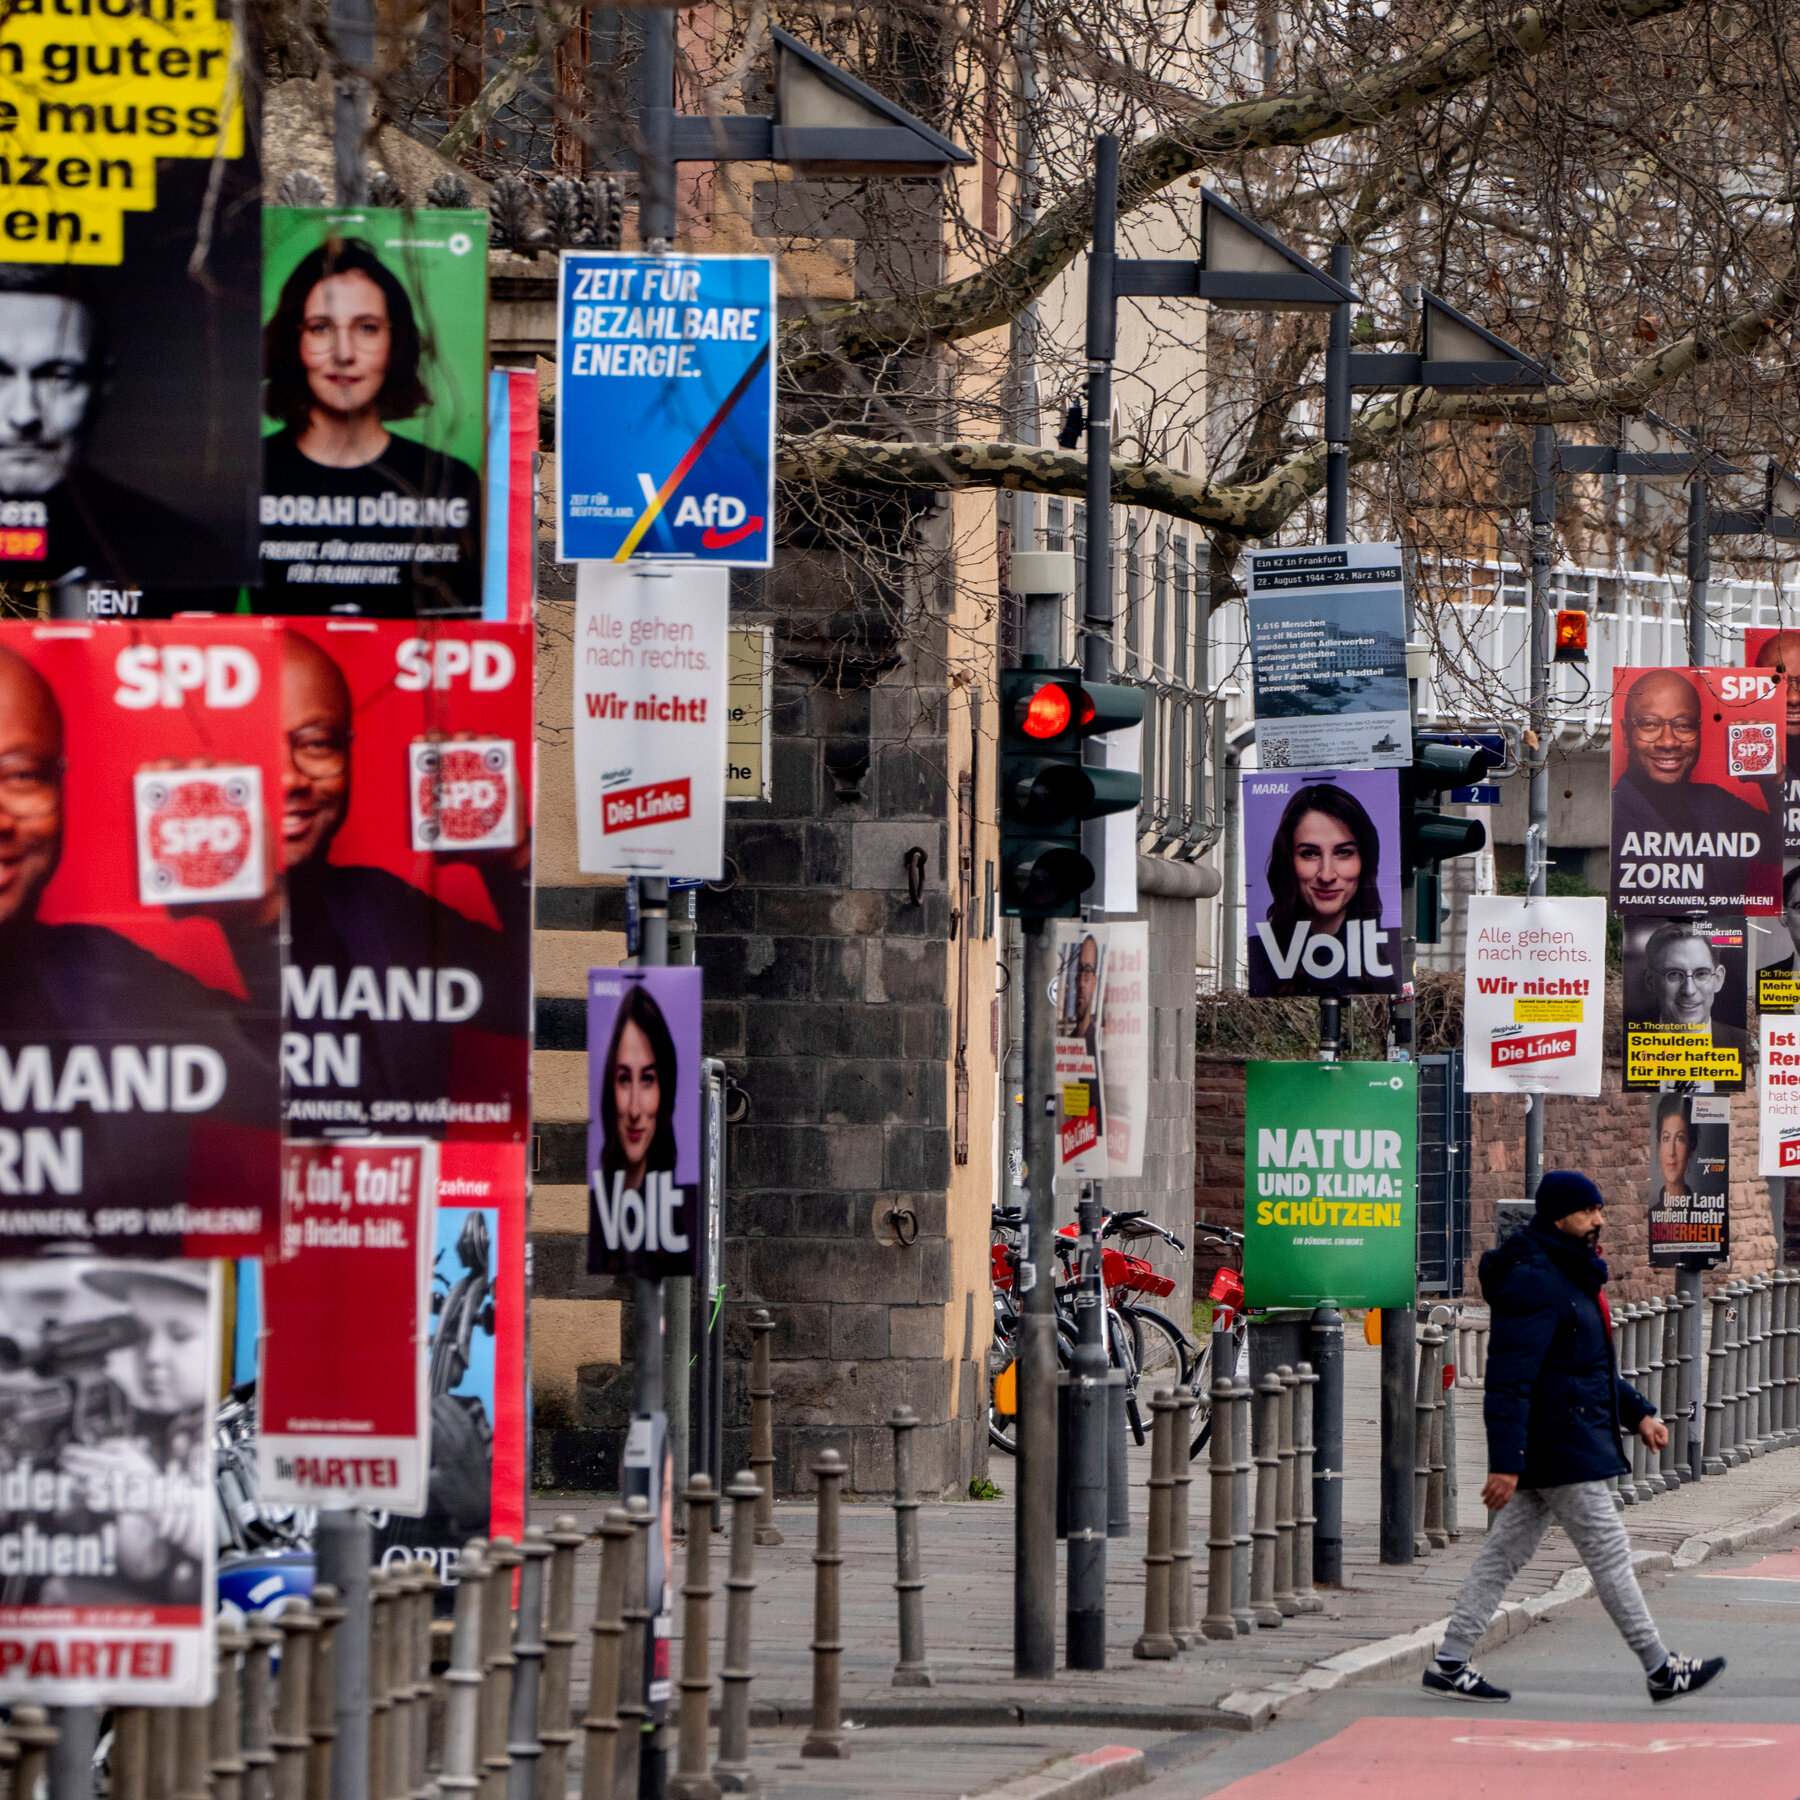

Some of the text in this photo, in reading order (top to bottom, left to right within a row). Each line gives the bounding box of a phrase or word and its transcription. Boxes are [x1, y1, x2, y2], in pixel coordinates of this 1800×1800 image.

[43, 38, 225, 84] guter
[37, 101, 221, 136] muss
[572, 261, 701, 302] ZEIT FÜR
[572, 306, 760, 341] BEZAHLBARE
[572, 343, 702, 378] ENERGIE.
[259, 496, 355, 525] BORAH
[673, 493, 746, 527] AfD
[1256, 555, 1343, 568] Ein KZ in Frankfurt
[1273, 574, 1302, 586] August
[1305, 574, 1325, 582] 1944
[1334, 573, 1349, 581] 24.
[1351, 571, 1372, 580] März
[1375, 570, 1396, 578] 1945
[586, 614, 694, 646] Alle gehen
[1282, 620, 1326, 630] Menschen
[1286, 630, 1325, 640] Nationen
[393, 638, 516, 691] SPD
[586, 644, 711, 671] nach rechts.
[114, 645, 261, 710] SPD
[1721, 676, 1776, 700] SPD
[585, 692, 707, 723] Wir nicht!
[1737, 743, 1767, 757] SPD
[726, 763, 752, 780] he
[1252, 783, 1290, 795] MARAL
[1471, 787, 1479, 802] 2
[607, 799, 635, 826] Die
[161, 817, 241, 855] SPD
[1620, 831, 1761, 858] ARMAND
[1619, 863, 1704, 889] ZORN
[1619, 894, 1773, 907] PLAKAT SCANNEN, SPD WÄHLEN!
[1478, 927, 1574, 947] Alle gehen
[1256, 919, 1394, 979] Volt
[1478, 945, 1592, 962] nach rechts.
[1477, 977, 1590, 996] Wir nicht!
[1763, 982, 1792, 990] Mehr
[1763, 994, 1800, 1003] Wenig
[1642, 1022, 1687, 1030] Thorsten
[1631, 1035, 1709, 1046] Schulden:
[1769, 1032, 1795, 1046] Ist
[1498, 1045, 1525, 1062] Die
[1631, 1050, 1735, 1062] Kinder haften
[1631, 1066, 1739, 1078] für ihre Eltern.
[1769, 1091, 1787, 1101] hat
[1769, 1104, 1798, 1115] nicht
[1257, 1128, 1402, 1169] NATUR
[355, 1156, 413, 1206] toi!
[1257, 1172, 1402, 1198] UND KLIMA:
[1664, 1192, 1725, 1209] Unser Land
[593, 1169, 690, 1253] Volt
[1256, 1197, 1401, 1227] SCHÜTZEN!
[1652, 1208, 1725, 1224] verdient mehr
[1652, 1224, 1725, 1242] SICHERHEIT.
[292, 1457, 398, 1488] PARTEI
[1455, 1672, 1479, 1690] N
[1672, 1675, 1691, 1691] N
